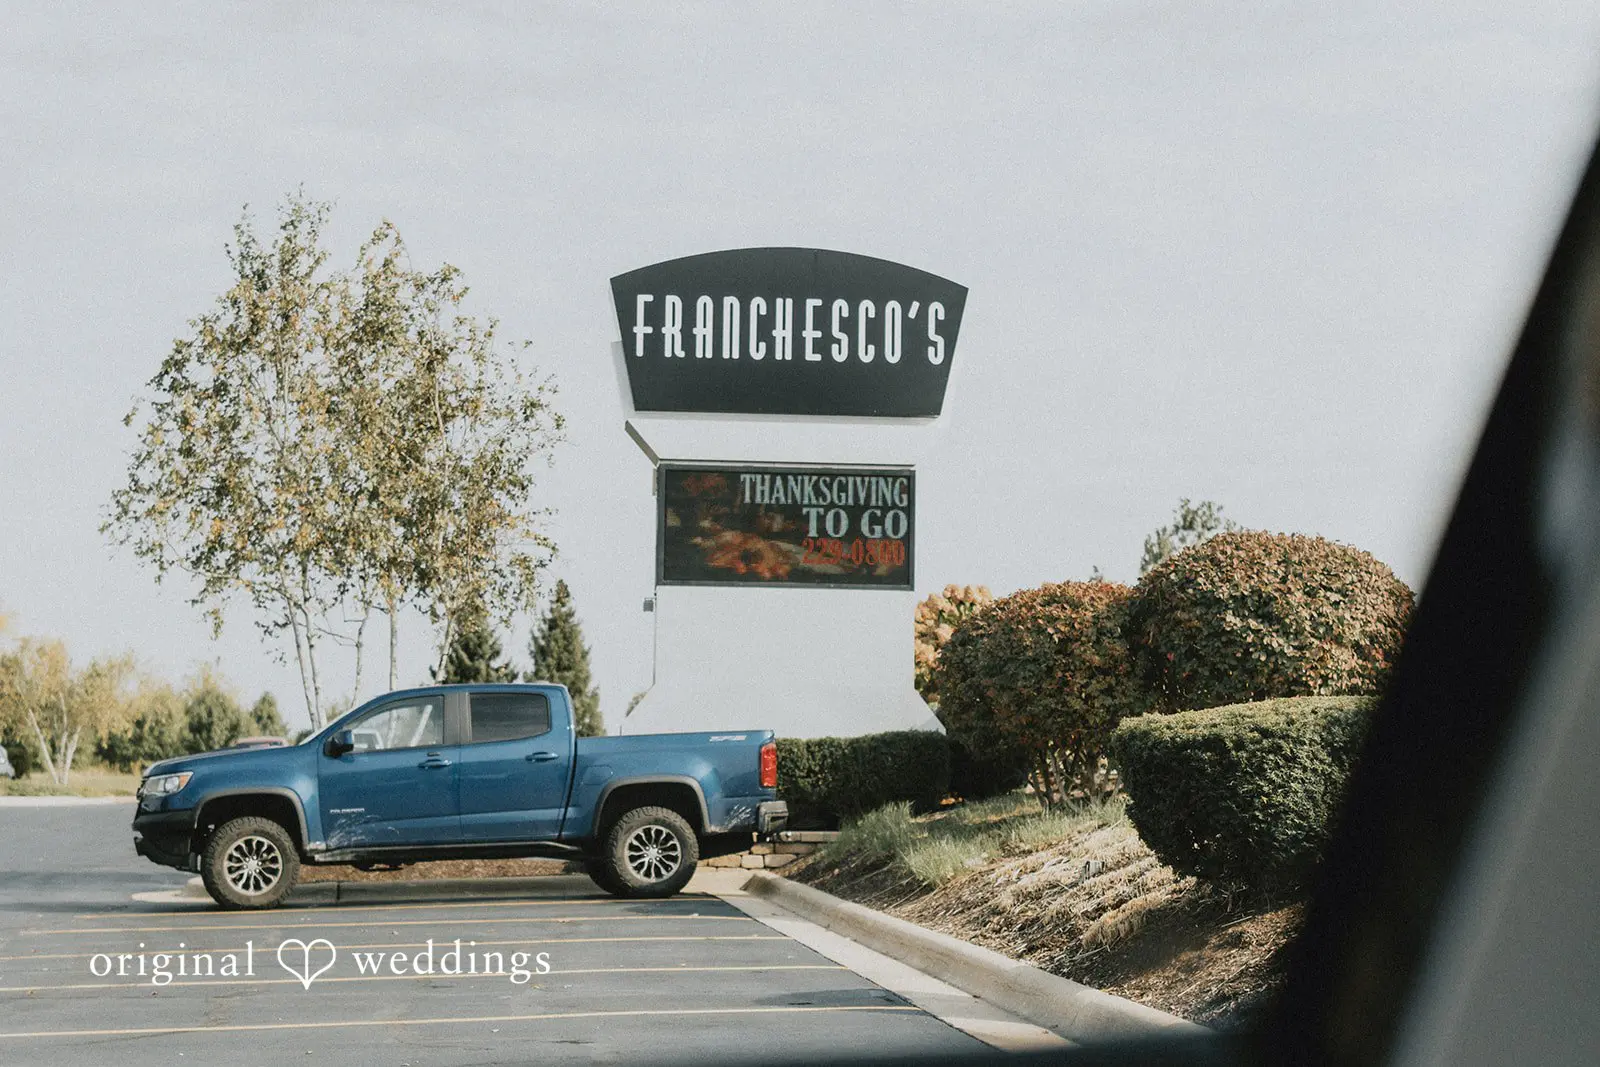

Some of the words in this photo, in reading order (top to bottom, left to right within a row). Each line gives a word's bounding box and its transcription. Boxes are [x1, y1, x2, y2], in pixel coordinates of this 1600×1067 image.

[633, 294, 945, 365] FRANCHESCO'S
[740, 473, 909, 507] THANKSGIVING
[803, 507, 850, 538] TO
[860, 508, 908, 539] GO
